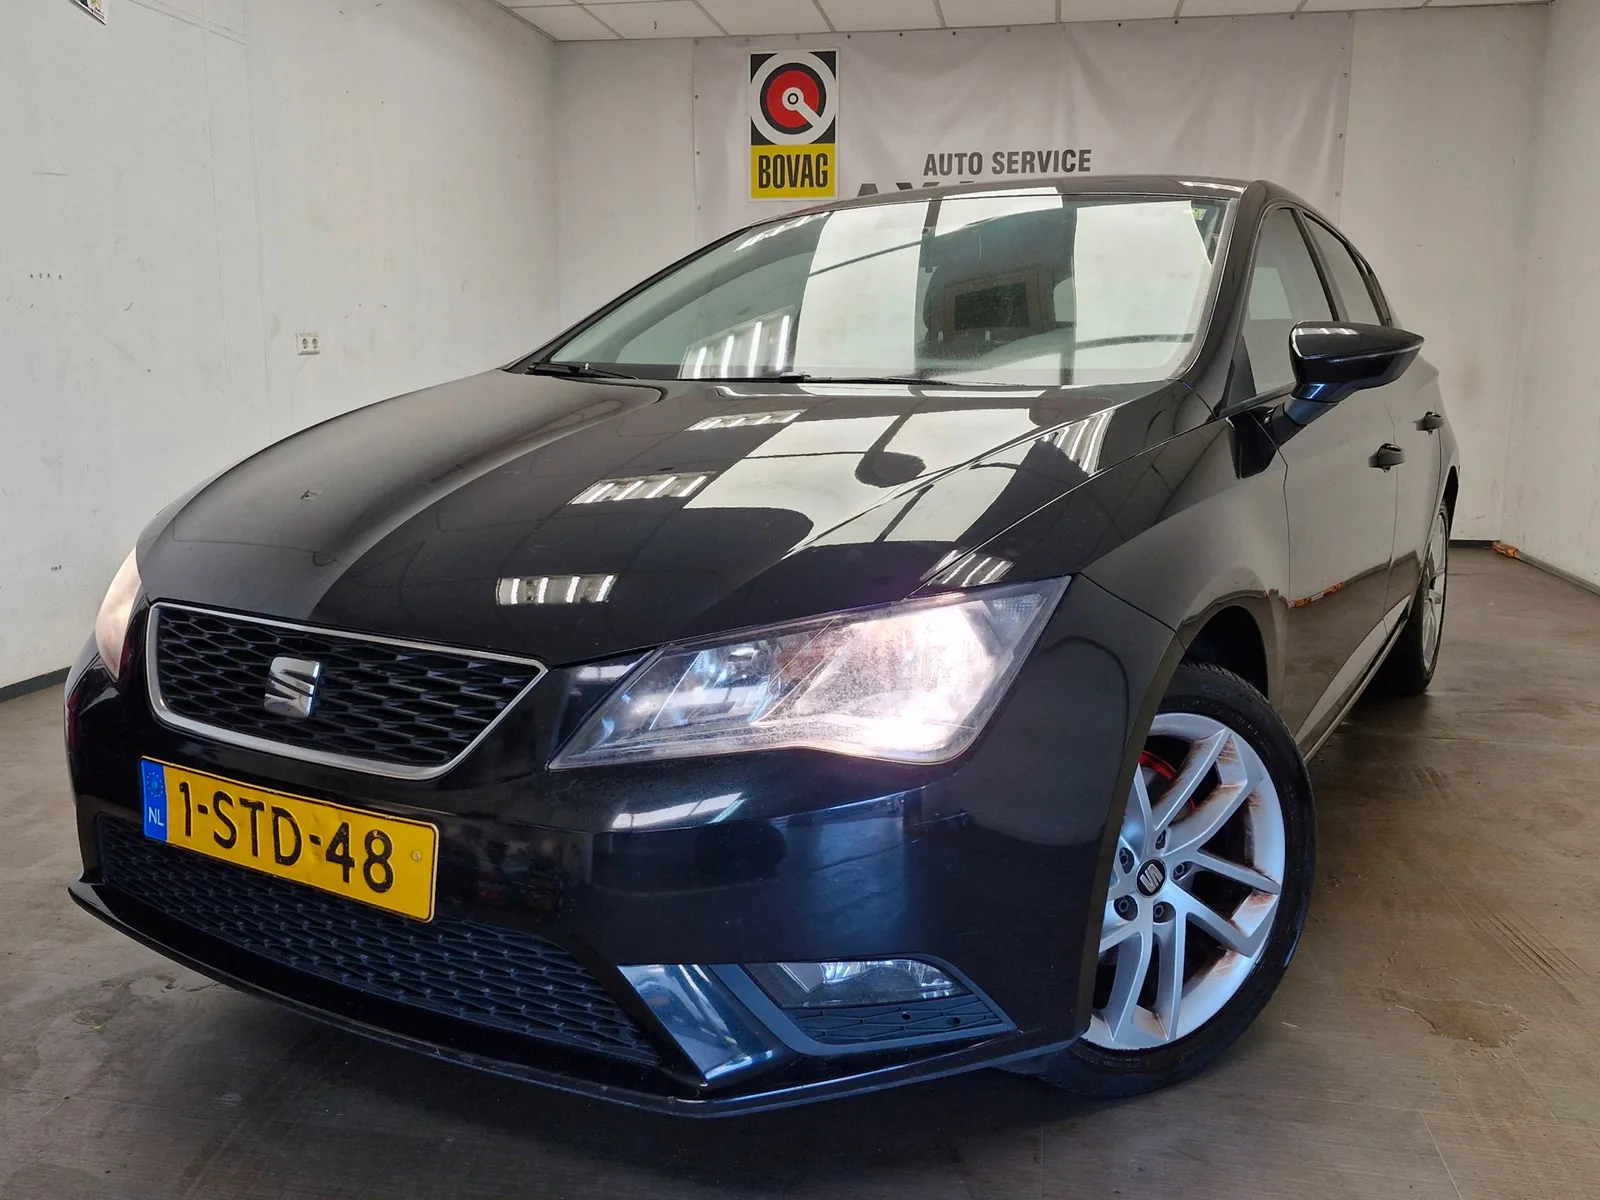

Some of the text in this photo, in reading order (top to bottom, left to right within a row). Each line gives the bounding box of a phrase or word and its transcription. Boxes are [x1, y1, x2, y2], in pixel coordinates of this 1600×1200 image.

[757, 153, 828, 189] BOVAG
[923, 149, 1092, 176] AUTO SERVICE
[148, 806, 164, 827] NL
[179, 781, 394, 893] 1-STD-48
